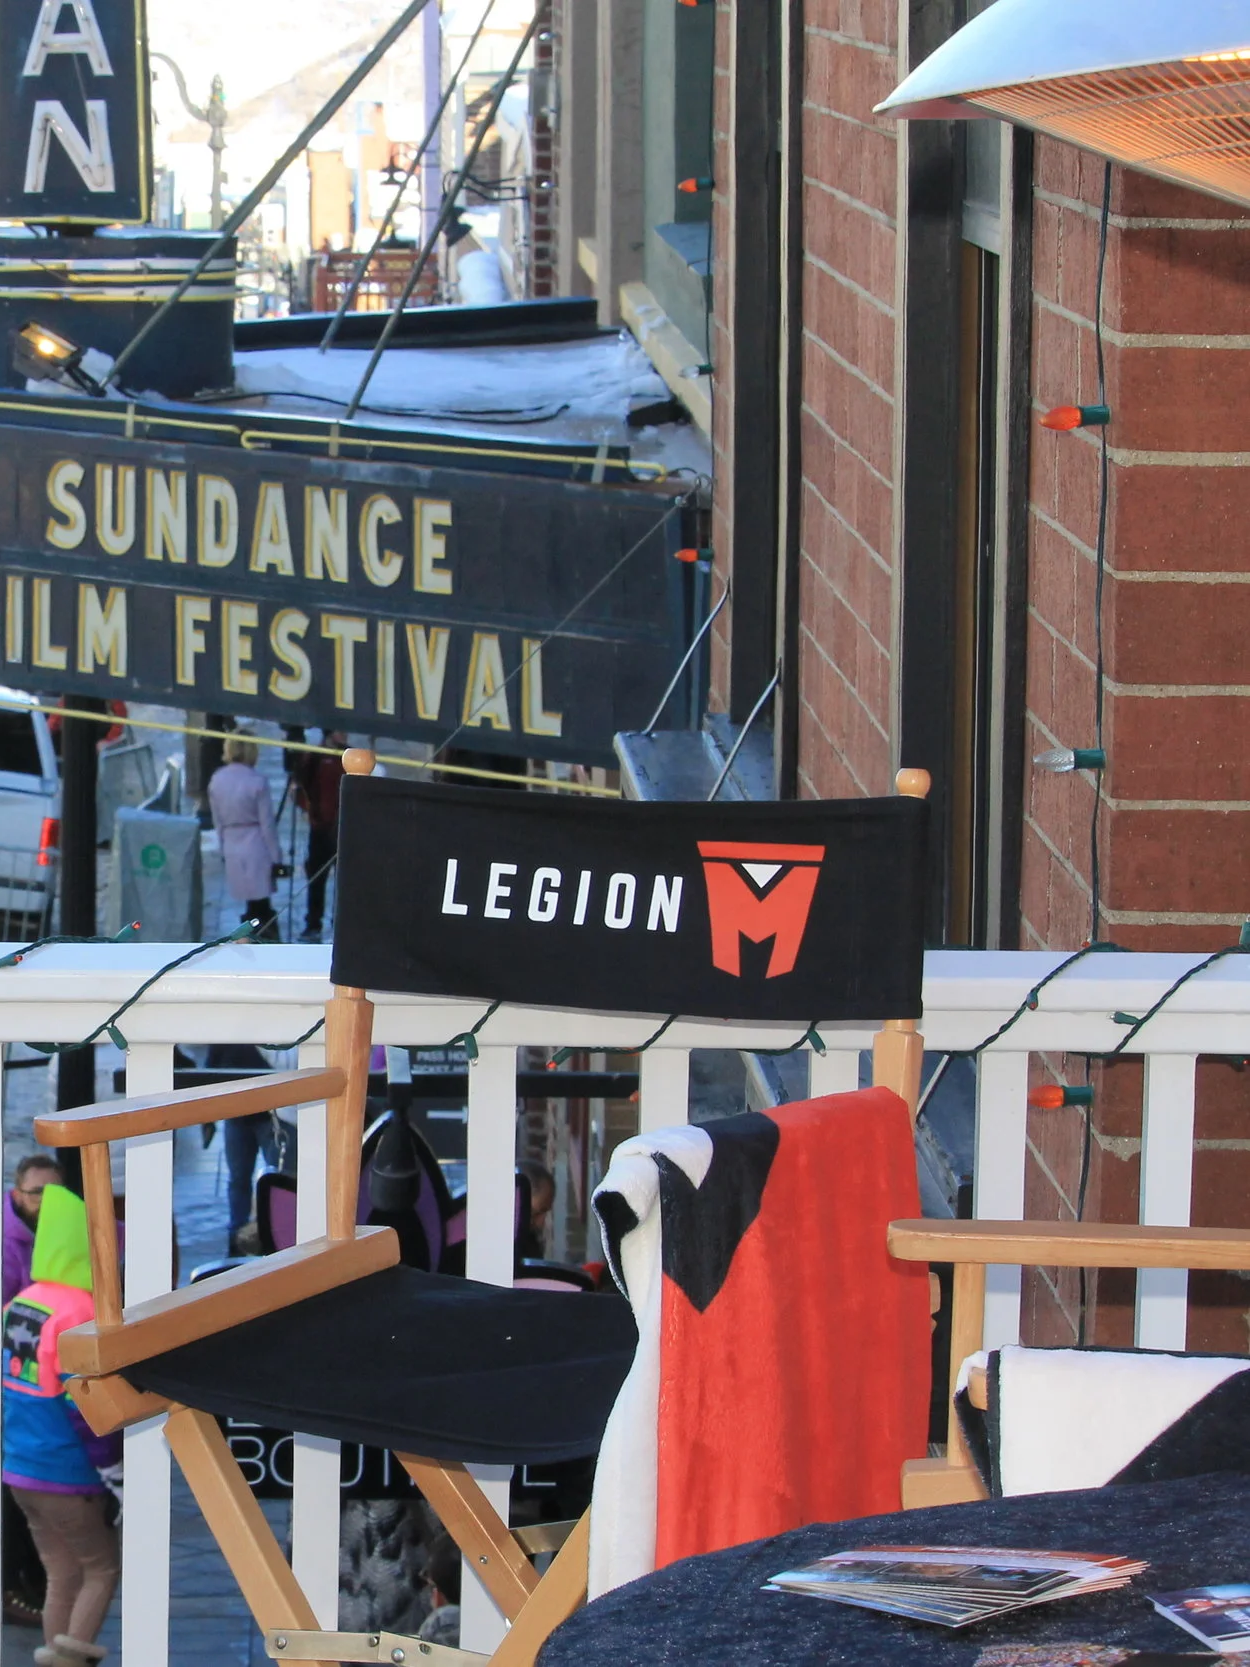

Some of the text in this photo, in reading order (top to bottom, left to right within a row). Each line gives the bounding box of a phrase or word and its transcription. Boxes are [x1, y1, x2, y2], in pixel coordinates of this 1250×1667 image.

[45, 458, 454, 595] SUNDANCE
[175, 594, 564, 737] FESTIVAL
[441, 858, 685, 933] LEGION
